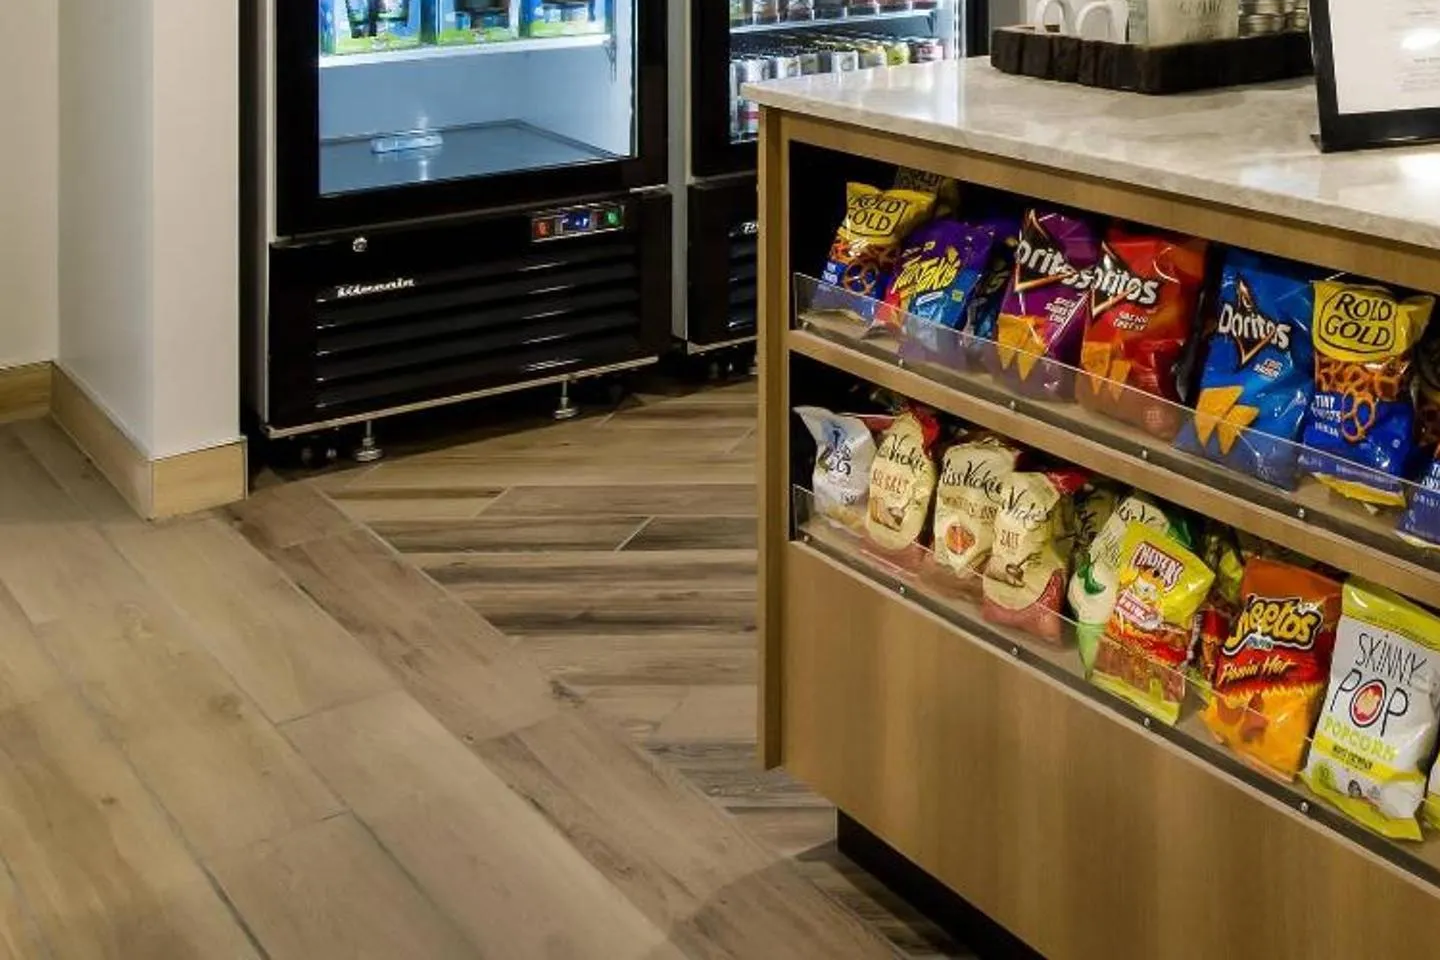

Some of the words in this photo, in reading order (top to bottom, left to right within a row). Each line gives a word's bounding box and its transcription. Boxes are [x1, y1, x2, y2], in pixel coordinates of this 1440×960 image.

[1014, 239, 1094, 290] oritos
[1217, 302, 1292, 350] Doritos
[1325, 313, 1391, 347] GOLD
[1334, 292, 1393, 322] ROLD
[1355, 632, 1428, 686] SKINNY
[1330, 668, 1410, 738] POP
